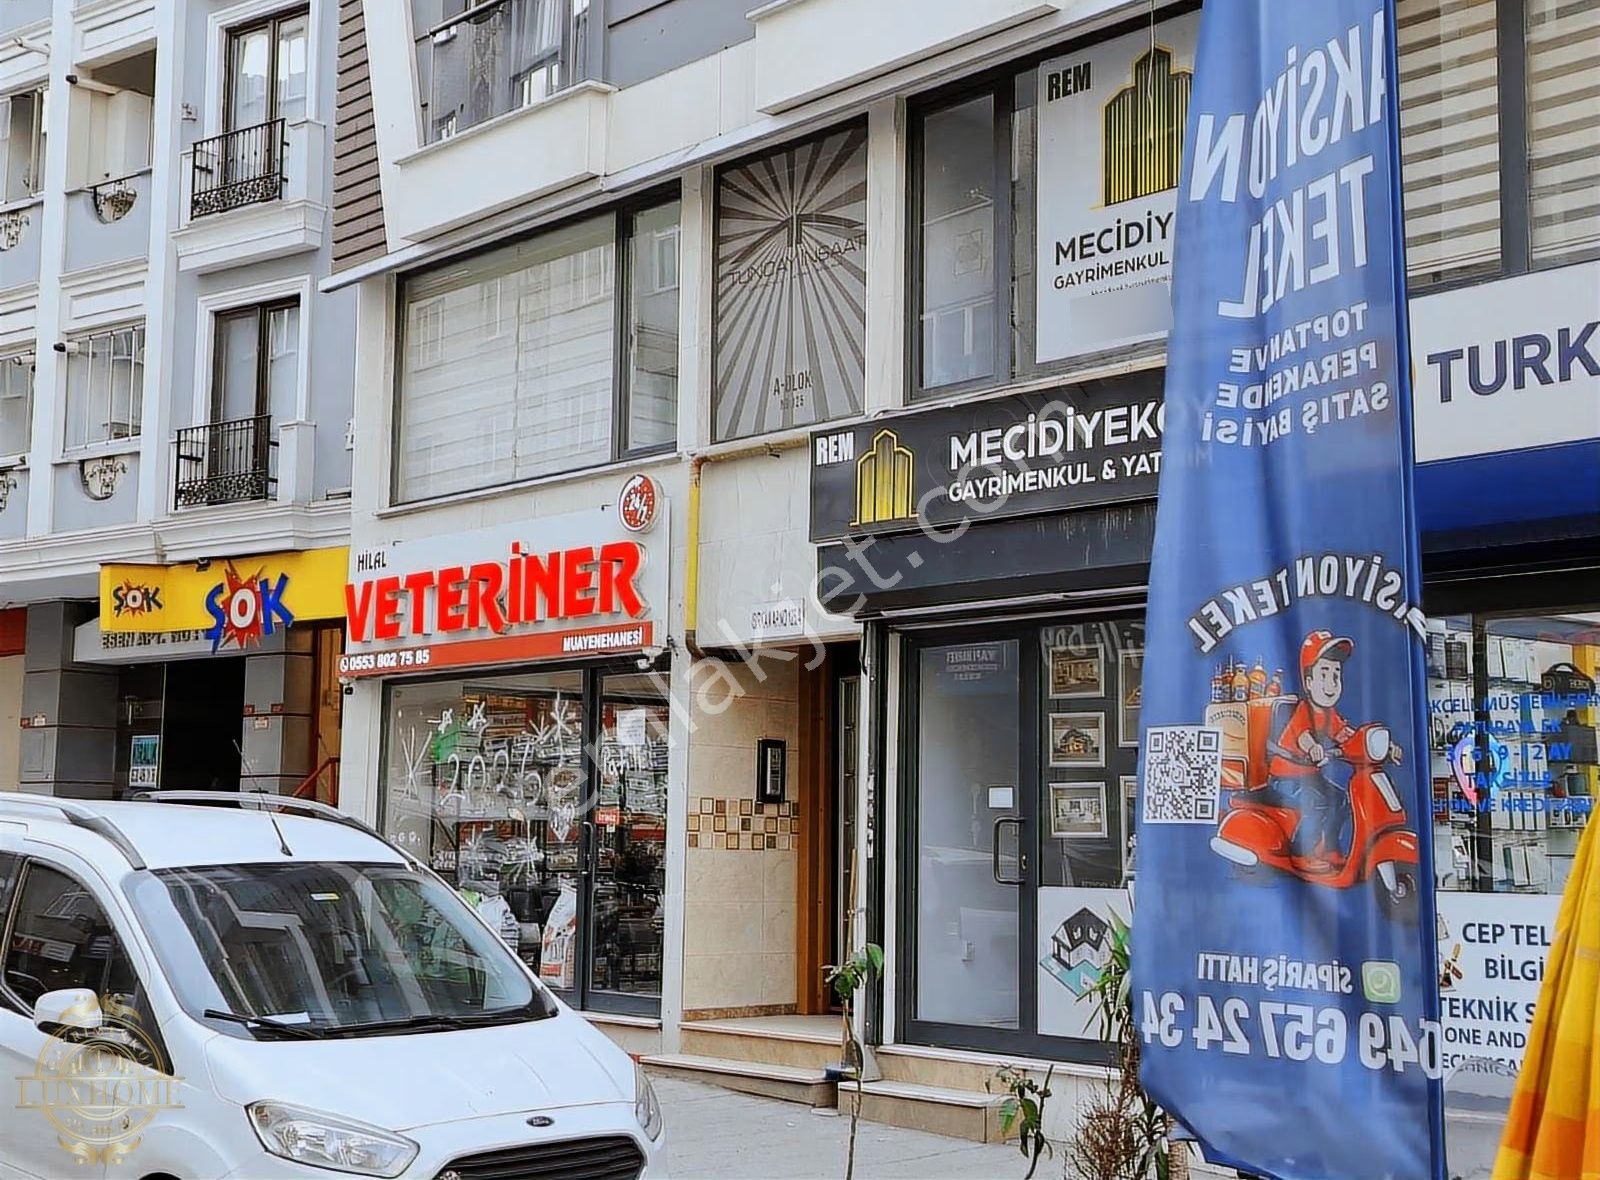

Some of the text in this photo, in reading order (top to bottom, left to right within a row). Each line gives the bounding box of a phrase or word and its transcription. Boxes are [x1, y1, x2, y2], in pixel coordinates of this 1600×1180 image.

[1047, 62, 1091, 102] REM
[1055, 210, 1174, 266] MECİDİY
[1054, 251, 1169, 290] GAYRİMENKUL
[1427, 321, 1600, 403] TURK
[816, 432, 854, 466] REM
[949, 463, 1096, 502] GAYRİMENKUL
[1102, 460, 1116, 480] &
[357, 550, 387, 573] HİLAL
[113, 585, 163, 617] ŞOK
[345, 541, 643, 643] VETERİNER
[205, 572, 294, 655] ŞOK
[563, 626, 643, 652] MUAYENEHANESİ
[400, 650, 414, 666] 75
[1549, 743, 1573, 759] AY
[1462, 922, 1551, 946] CEP TEL
[1485, 954, 1544, 981] BİLGİ
[1441, 996, 1519, 1023] TEKNİK
[1486, 1030, 1526, 1048] AND
